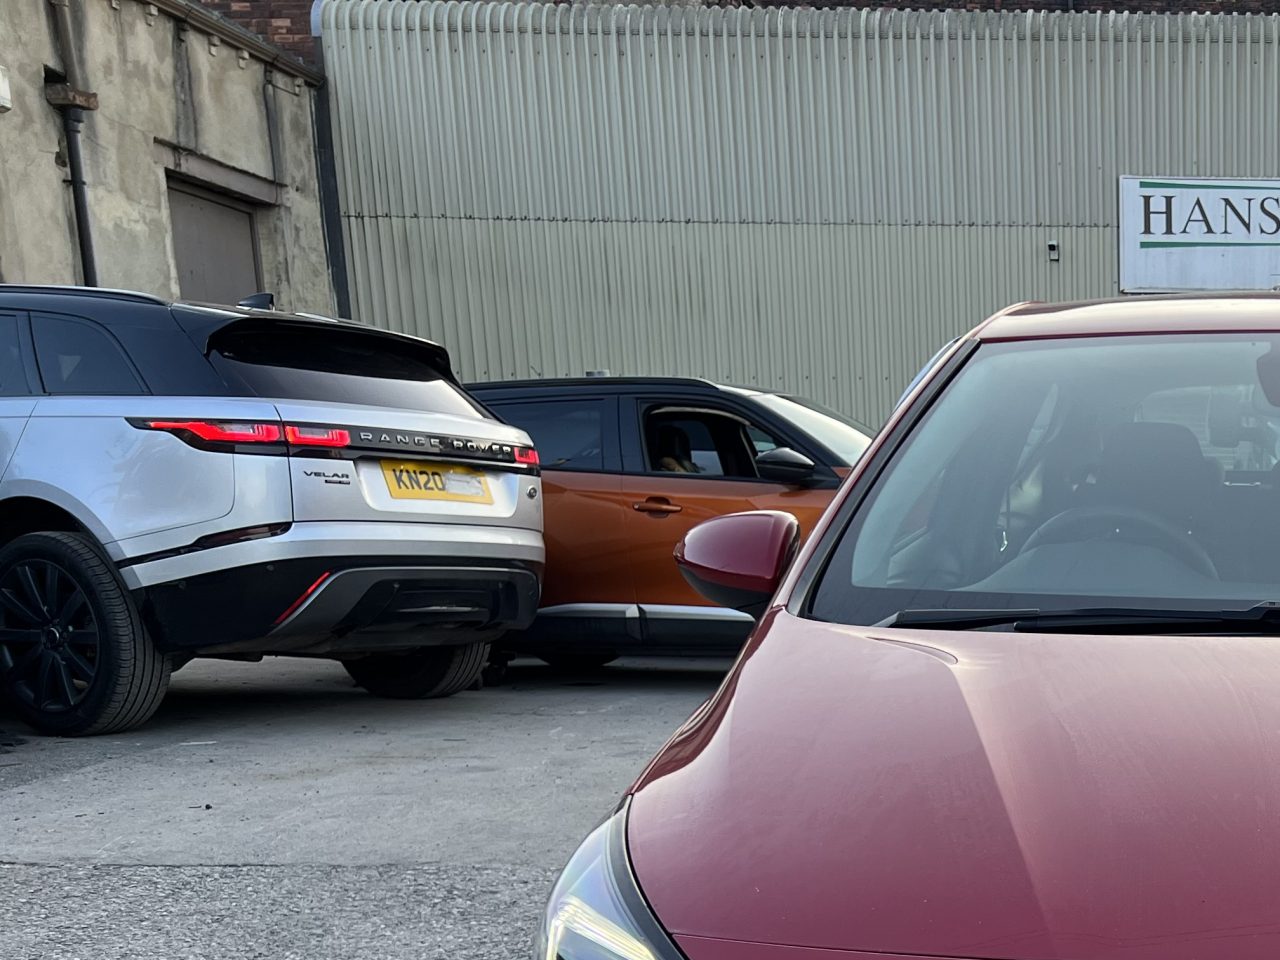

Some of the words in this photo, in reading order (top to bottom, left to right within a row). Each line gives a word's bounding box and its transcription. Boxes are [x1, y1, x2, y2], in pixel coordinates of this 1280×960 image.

[359, 432, 440, 448] RANGE
[452, 440, 511, 453] ROVER
[303, 470, 349, 479] VELAR
[392, 468, 446, 491] KN20
